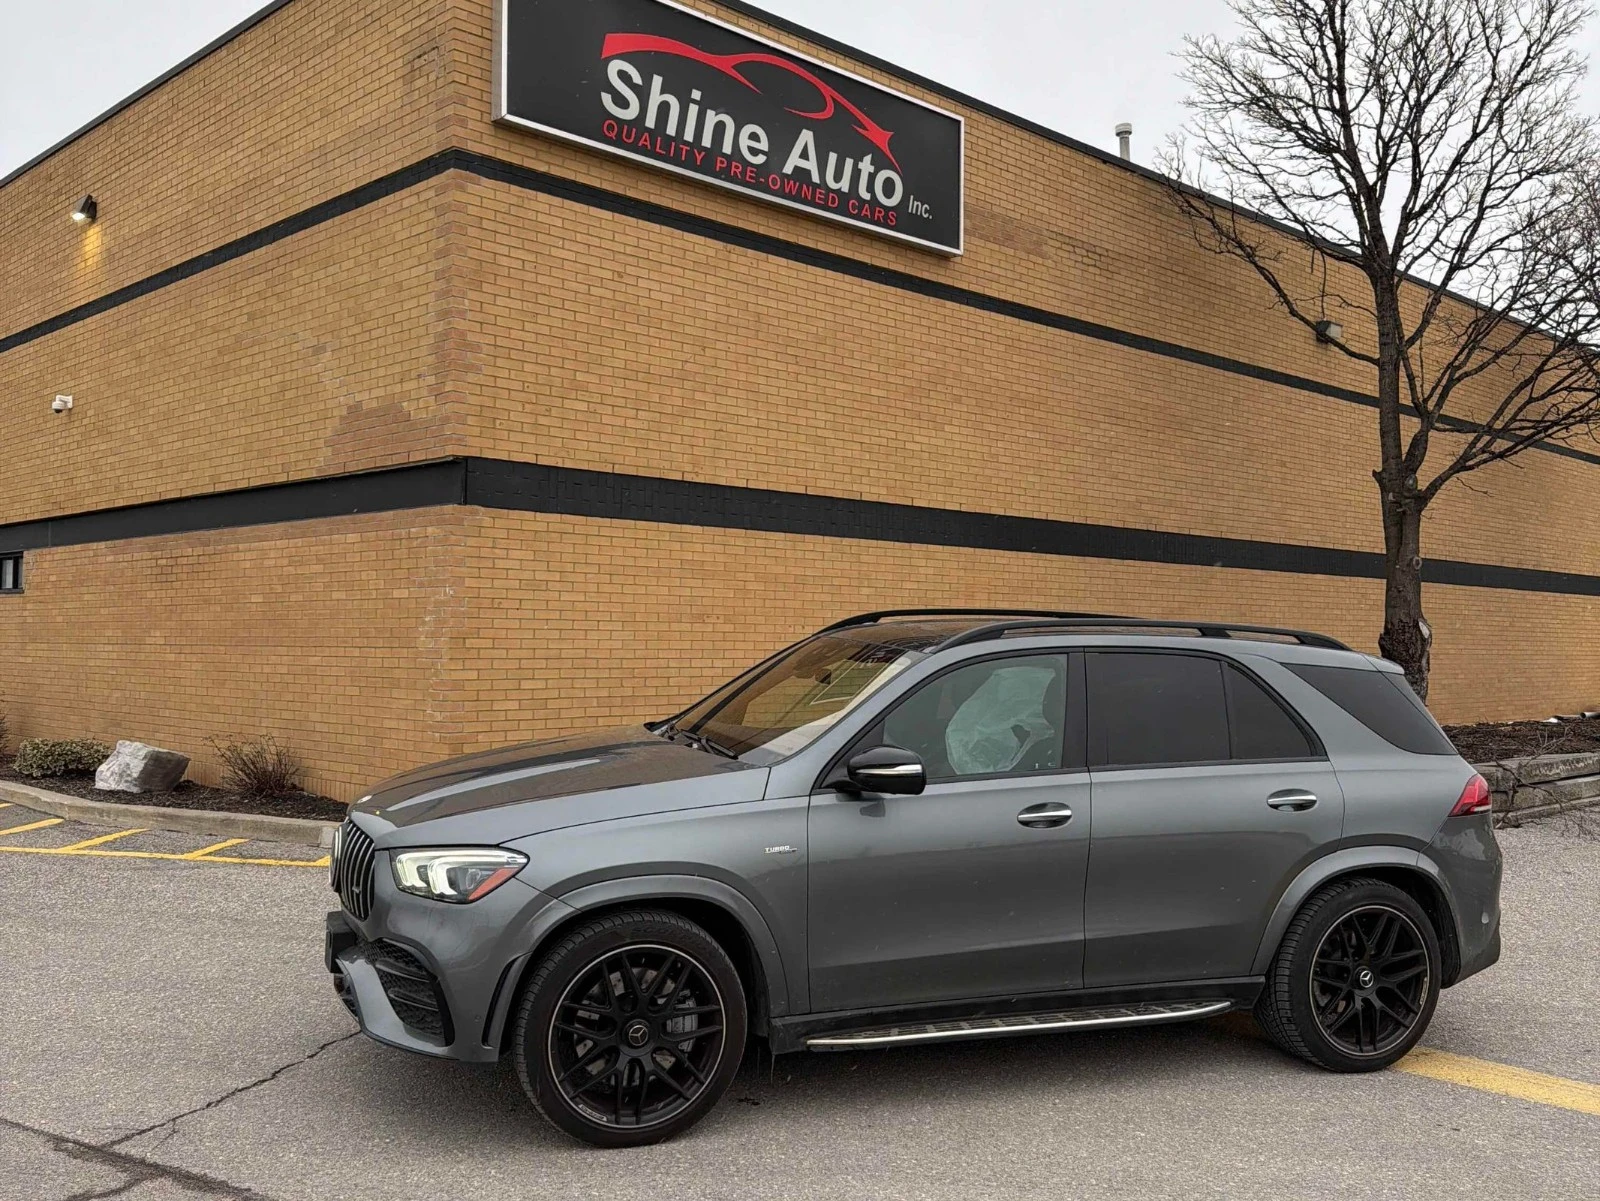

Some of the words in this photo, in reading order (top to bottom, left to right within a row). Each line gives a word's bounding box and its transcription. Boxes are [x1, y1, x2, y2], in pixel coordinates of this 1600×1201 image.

[601, 59, 769, 165] Shine
[781, 128, 904, 207] Auto
[908, 194, 933, 219] Inc.
[602, 119, 706, 166] QUALITY
[715, 156, 839, 209] PRE-OWNED
[848, 199, 898, 227] CARS
